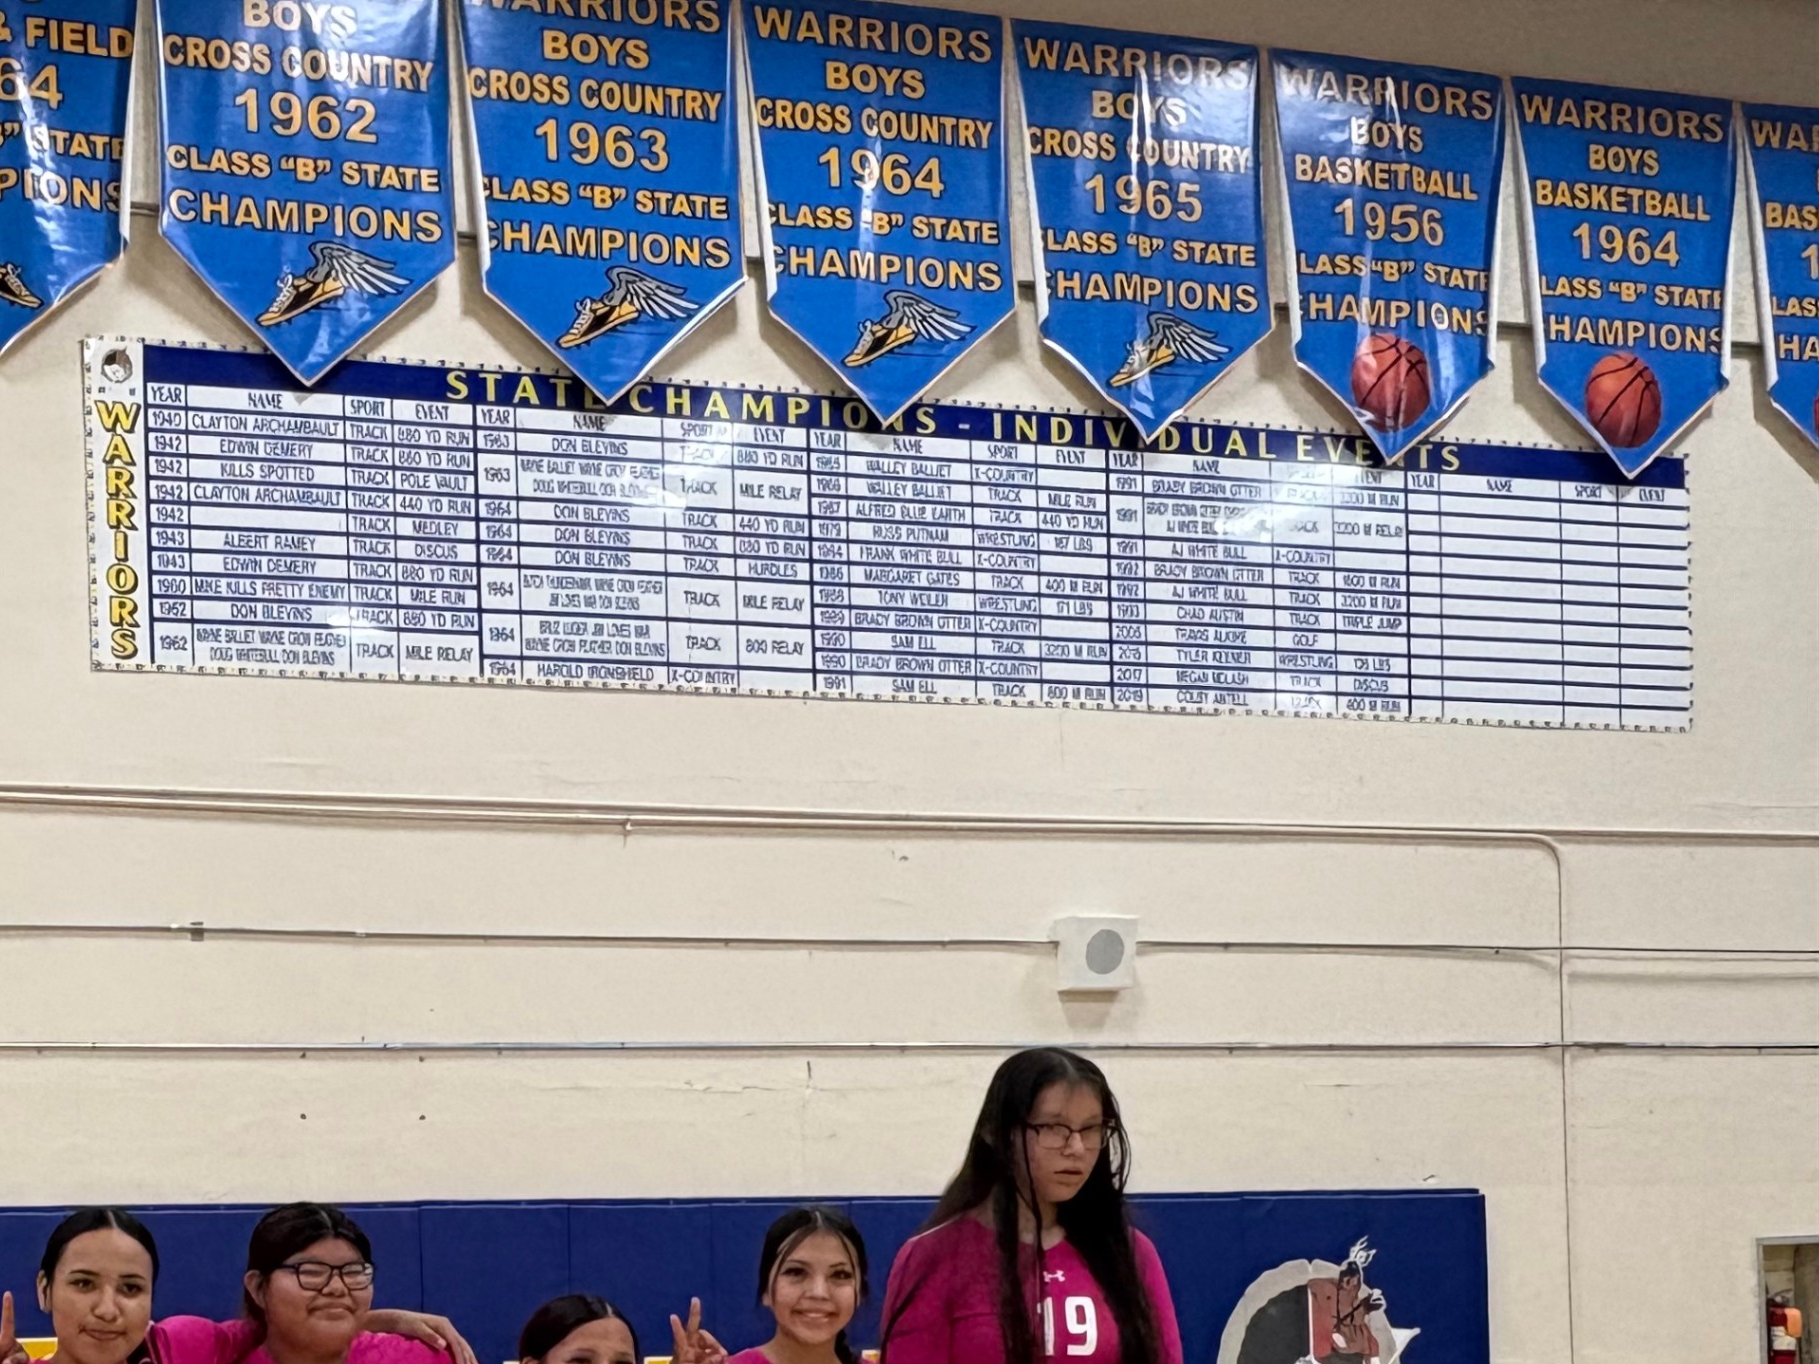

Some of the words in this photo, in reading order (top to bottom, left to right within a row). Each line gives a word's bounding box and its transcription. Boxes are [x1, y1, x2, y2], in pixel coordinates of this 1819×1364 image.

[243, 0, 357, 39] BOYS
[484, 0, 721, 33] RIORS
[754, 5, 993, 63] WARRIORS
[25, 16, 133, 58] FIELD
[542, 29, 650, 70] BOYS
[163, 34, 271, 76] CROSS
[282, 47, 433, 92] COUNTRY
[825, 61, 926, 99] BOYS
[1024, 37, 1248, 91] WARRIORS
[469, 67, 570, 106] CROSS
[580, 78, 722, 122] COUNTRY
[1280, 67, 1493, 121] WARRIORS
[235, 88, 378, 143] 1962
[757, 98, 851, 134] CROSS
[861, 107, 993, 149] COUNTRY
[1351, 115, 1423, 153] BOYS
[1520, 94, 1724, 143] WARRIORS
[535, 118, 670, 173] 1963
[1028, 126, 1116, 162] CROSS
[1589, 144, 1659, 177] BOYS
[166, 145, 271, 178] CLASS
[342, 161, 440, 192] STATE
[818, 146, 944, 198] 1964
[1295, 153, 1478, 201] BASKETBALL
[168, 189, 442, 243] CHAMPIONS
[635, 189, 728, 220] STATE
[1085, 173, 1203, 222] 1965
[1536, 179, 1711, 222] BASKETBALL
[912, 215, 999, 244] STATE
[1335, 197, 1444, 247] 1956
[1045, 228, 1117, 255] LASS
[1173, 240, 1256, 267] STATE
[1299, 252, 1367, 276] LASS
[1573, 222, 1680, 268] 1964
[1047, 270, 1258, 313] HAMPIONS
[1541, 276, 1602, 300] LASS
[1300, 292, 1487, 336] HAMPION
[1549, 314, 1721, 354] HAMPION
[151, 385, 181, 403] YEAR
[350, 399, 385, 417] SPORT
[192, 413, 248, 431] CLAYTON
[350, 423, 387, 440] TRACK
[629, 383, 936, 434] CHAMPIOS
[993, 411, 1277, 459] INDIVDUAL
[1297, 435, 1460, 471] EVETS
[351, 446, 388, 463] TRACK
[194, 485, 249, 501] CLAYTON
[351, 469, 389, 486] TRACK
[401, 473, 431, 489] POLE
[351, 492, 390, 508] TRACK
[94, 400, 142, 659] WARRIORS
[352, 516, 391, 532] TRACK
[353, 539, 391, 555] TRACK
[353, 562, 392, 579] TRACK
[354, 585, 392, 602] TRACK
[1037, 1296, 1098, 1356] 19
